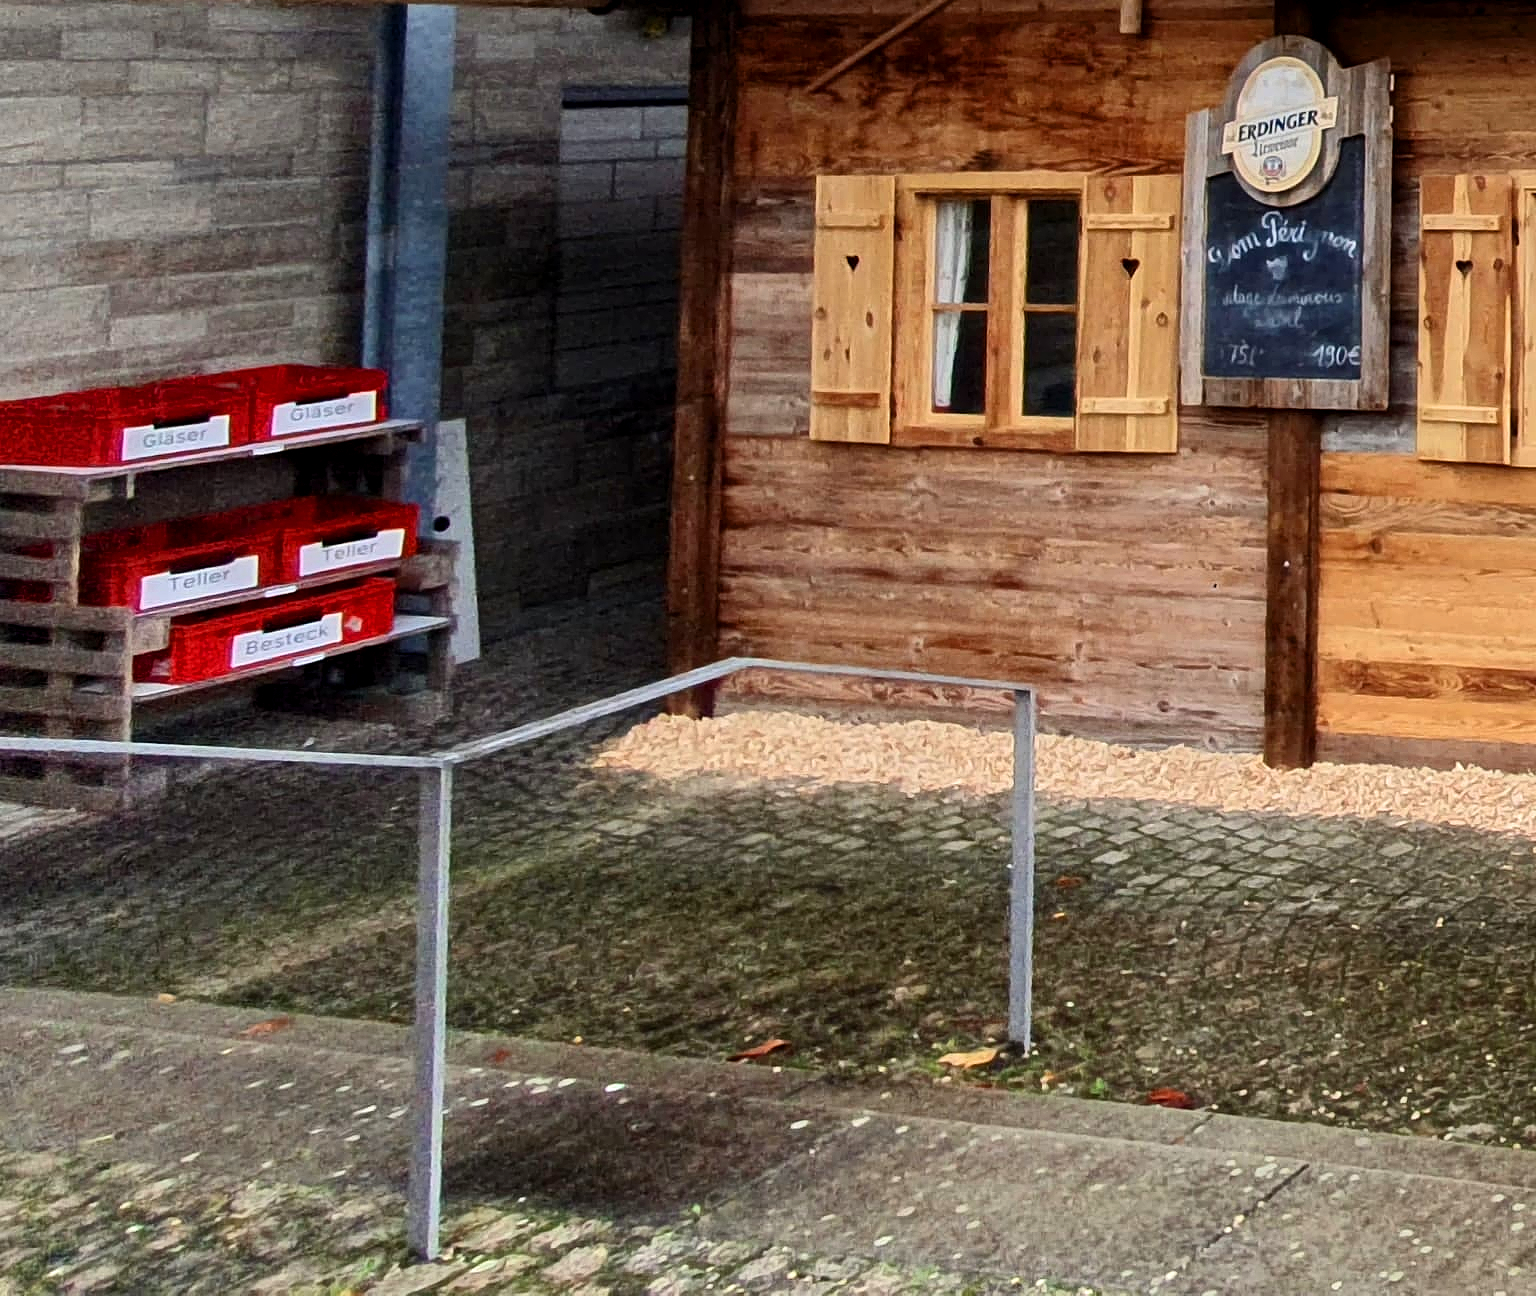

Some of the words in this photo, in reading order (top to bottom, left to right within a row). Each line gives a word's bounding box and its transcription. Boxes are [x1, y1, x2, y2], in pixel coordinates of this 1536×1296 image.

[1238, 109, 1319, 143] ERDINGER
[1311, 343, 1361, 369] 190€
[322, 540, 378, 562] Teller
[168, 568, 232, 592] Teller
[245, 623, 330, 656] Besteck
